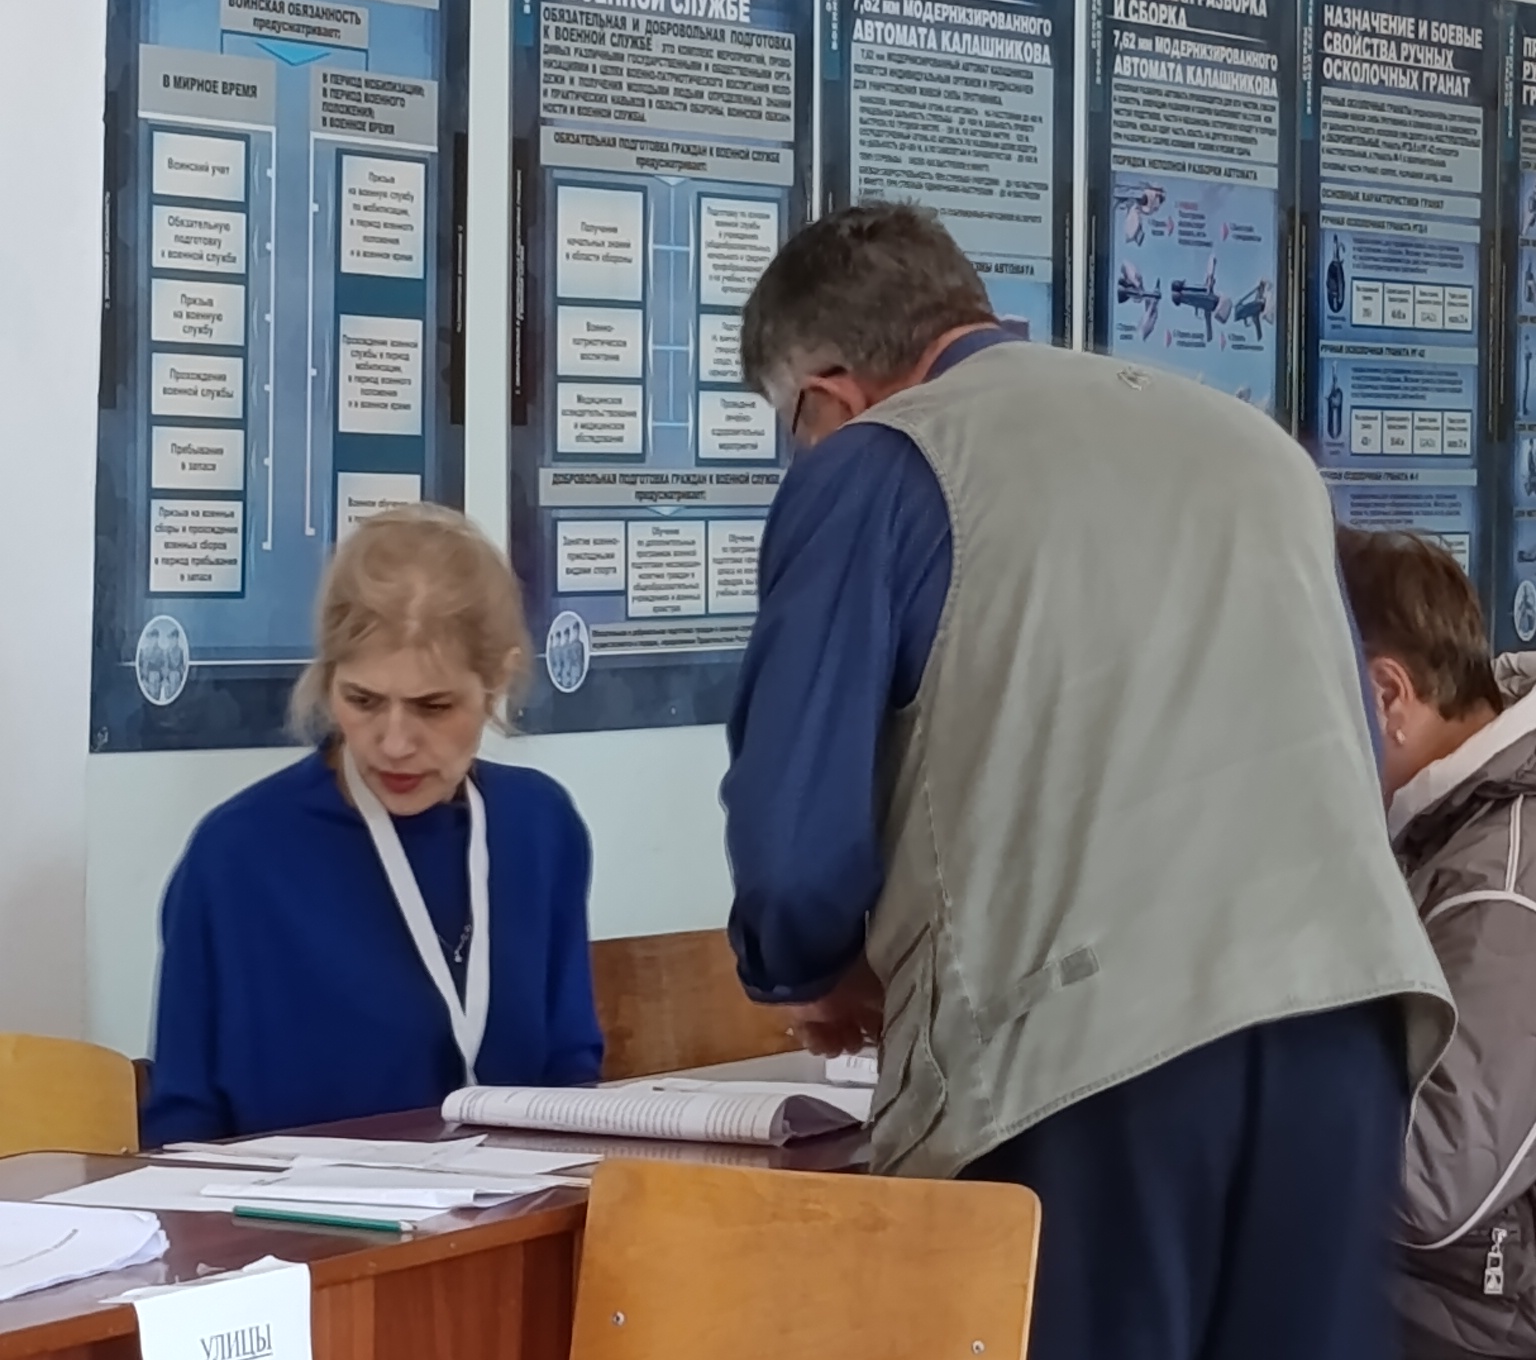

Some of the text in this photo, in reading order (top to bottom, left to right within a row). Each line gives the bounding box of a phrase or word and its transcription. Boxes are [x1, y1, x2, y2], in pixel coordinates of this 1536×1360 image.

[287, 3, 361, 26] ОБЯЗАННОСТЬ
[882, 0, 900, 14] мм
[543, 7, 792, 51] ОБЯЗАТЕЛЬНАЯ И ДОБРОВОЛЬНАЯ ПОДГОТОВКА
[544, 25, 652, 51] К ВОЕННОЙ СЛУЖБЕ
[1324, 4, 1483, 50] НАЗНАЧЕНИЕ И БОЕВЫЕ
[853, 18, 1051, 65] АВТОМАТА КАЛАШНИКОВА
[1113, 30, 1278, 71] 7,62 мм МОДЕРНИЗИРОВАННОГО
[1323, 31, 1454, 69] СВОЙСТВА РУЧНЫХ
[163, 74, 257, 98] В МИРНОЕ ВРЕМЯ
[322, 72, 328, 83] В
[330, 73, 362, 89] ПЕРИОД
[1114, 55, 1278, 98] АВТОМАТА КАЛАШНИКОВА
[1323, 57, 1471, 98] ОСКОЛОЧНЫХ ГРАНАТ
[322, 87, 405, 108] В ПЕРИОД ВОЕННОГО
[322, 117, 395, 135] В ВОЕННОЕ ВРЕМЯ
[554, 132, 780, 163] ОБЯЗАТЕЛЬНАЯ ПОДГОТОВКА ГРАЖДАН К ВОЕННОЙ СЛУЖБЕ
[168, 158, 209, 172] Воинский
[168, 215, 230, 234] Обязательную
[174, 234, 222, 248] подготовку
[181, 294, 214, 307] Призыв
[183, 324, 213, 338] службу
